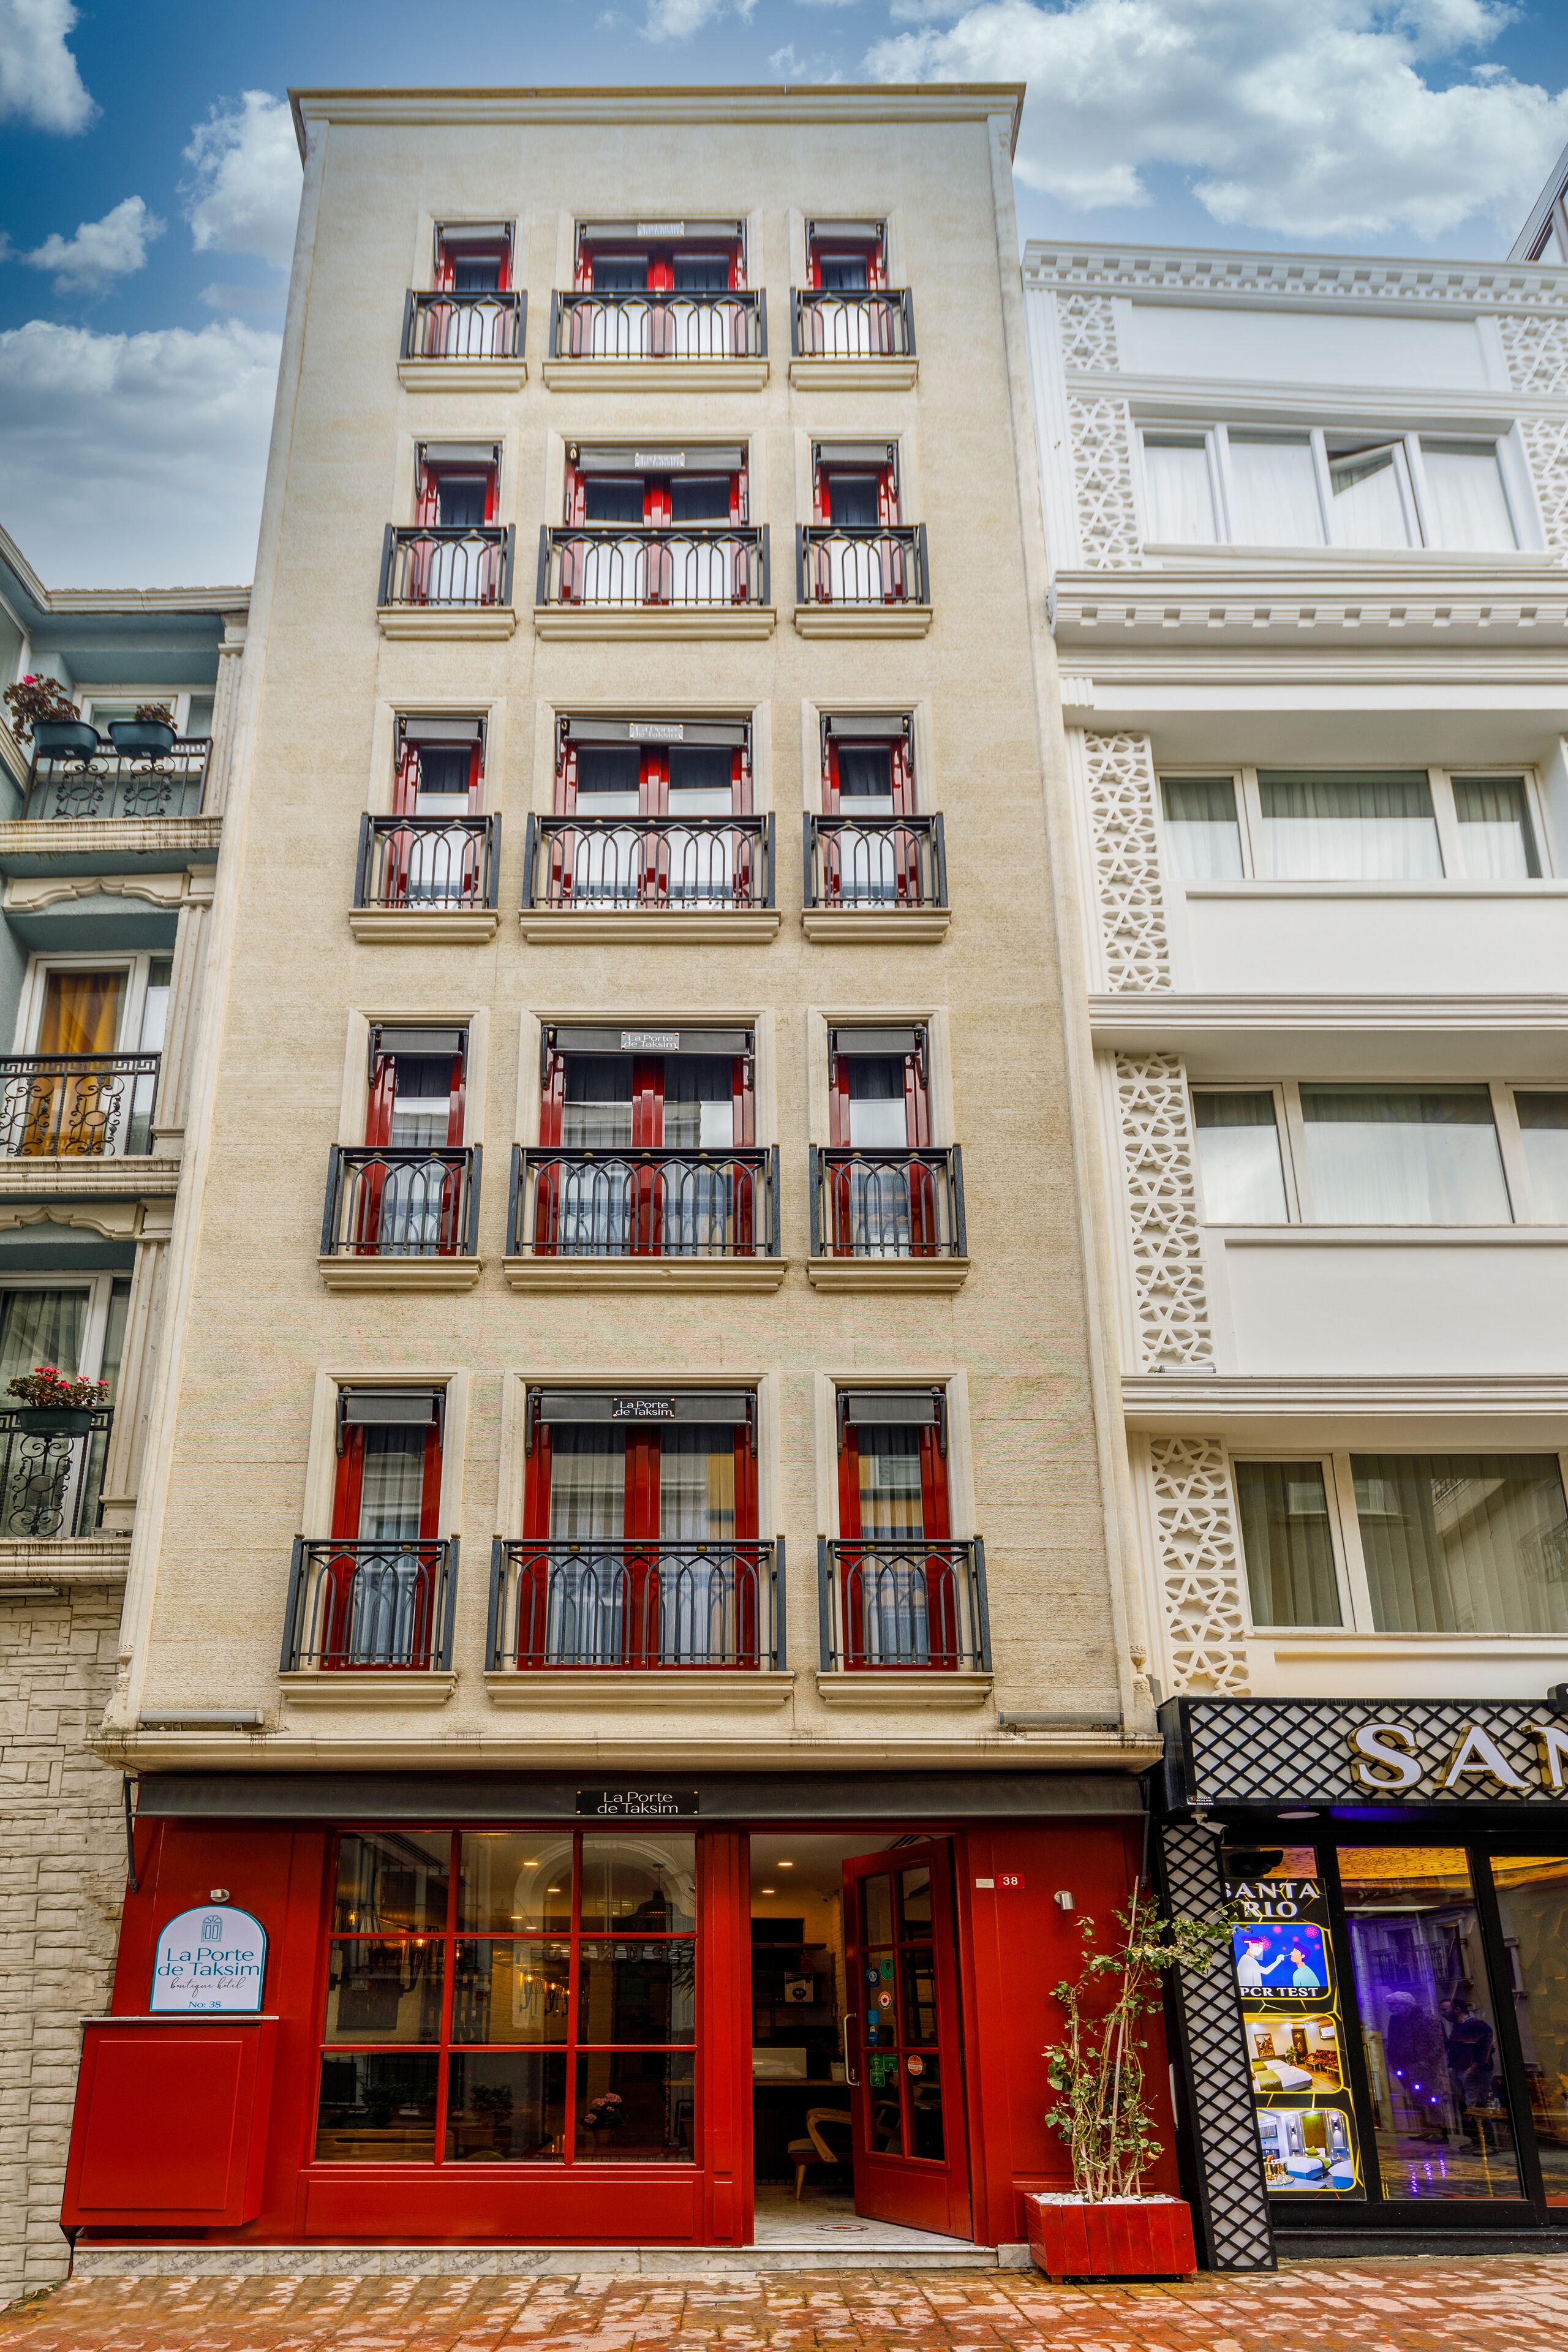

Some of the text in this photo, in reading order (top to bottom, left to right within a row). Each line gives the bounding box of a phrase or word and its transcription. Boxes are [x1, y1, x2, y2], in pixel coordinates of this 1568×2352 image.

[604, 1792, 673, 1803] La Porte
[597, 1803, 678, 1814] de Taksim
[1003, 1876, 1018, 1885] 38
[1243, 1901, 1297, 1918] RIO
[167, 1948, 254, 1961] La Porte
[157, 1962, 260, 1976] de Taksim
[170, 1977, 246, 1998] boutique hotel
[1239, 1987, 1319, 1997] PCR TEST
